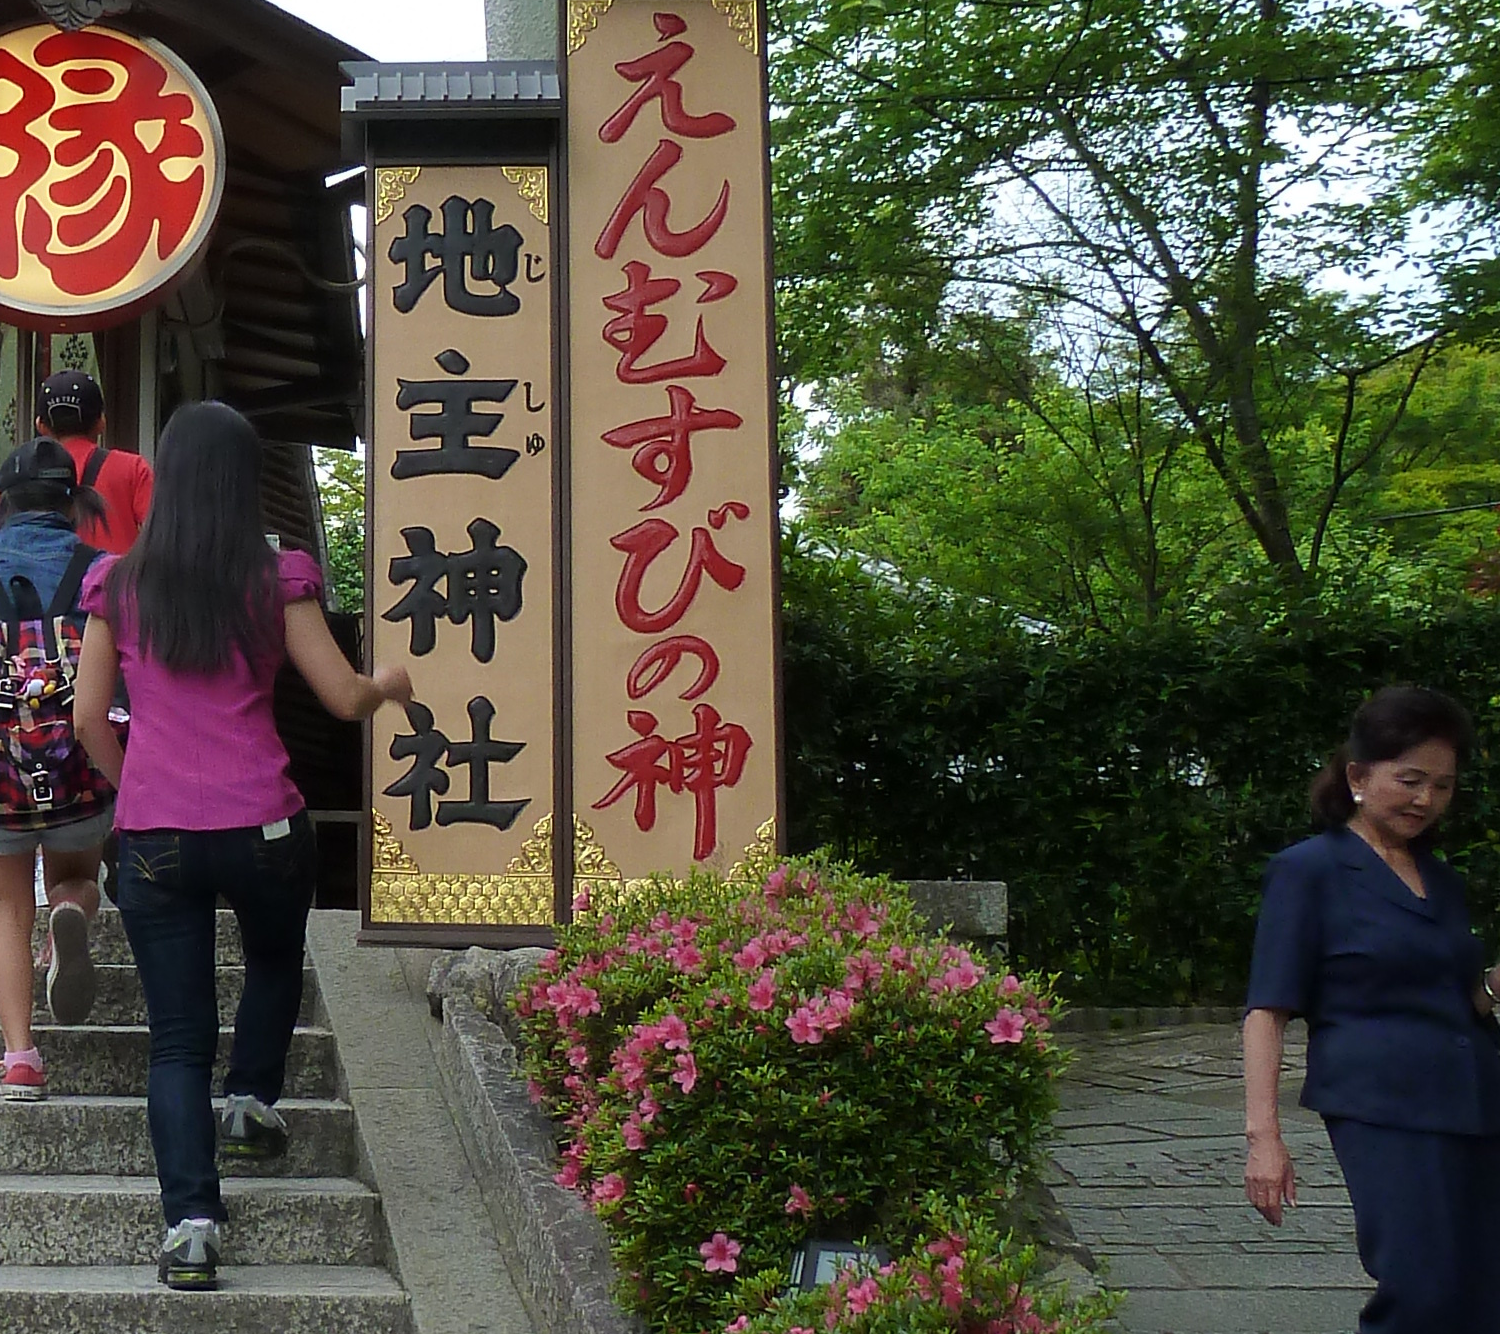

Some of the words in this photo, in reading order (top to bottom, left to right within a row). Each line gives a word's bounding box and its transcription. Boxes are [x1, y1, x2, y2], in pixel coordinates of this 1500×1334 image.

[381, 194, 533, 831] 地主神社
[522, 251, 547, 284] じ
[592, 11, 754, 862] えんむすびの神
